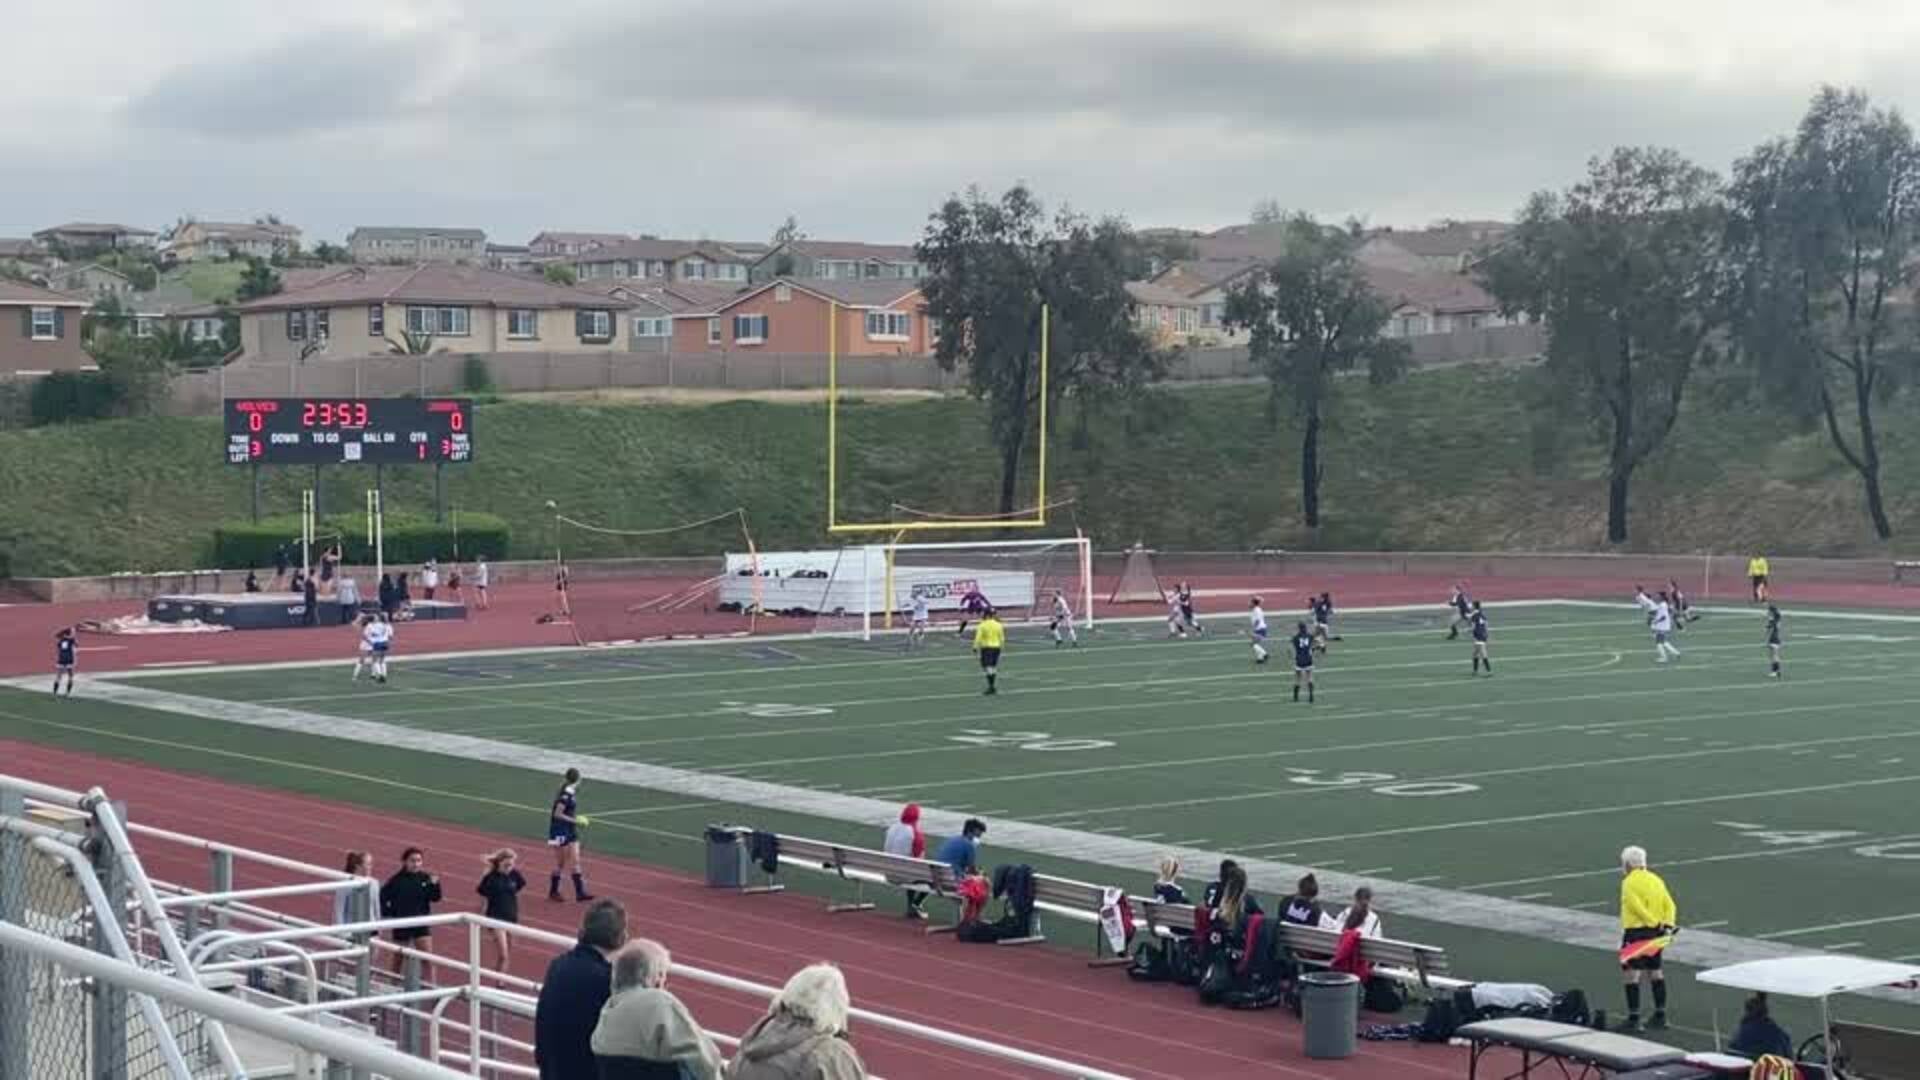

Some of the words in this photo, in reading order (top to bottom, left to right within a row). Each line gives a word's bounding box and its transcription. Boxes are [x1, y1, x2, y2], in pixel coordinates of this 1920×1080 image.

[303, 403, 367, 426] 23:53
[250, 413, 262, 431] 0
[451, 412, 463, 431] 0
[271, 433, 299, 443] DOWN
[312, 433, 325, 442] TO
[326, 433, 339, 442] GO
[363, 433, 382, 442] BALL
[410, 432, 428, 442] QTR
[251, 441, 262, 456] 3
[419, 443, 425, 460] 1
[442, 439, 450, 455] 3
[230, 453, 249, 462] LEFT
[451, 451, 468, 460] LEFT
